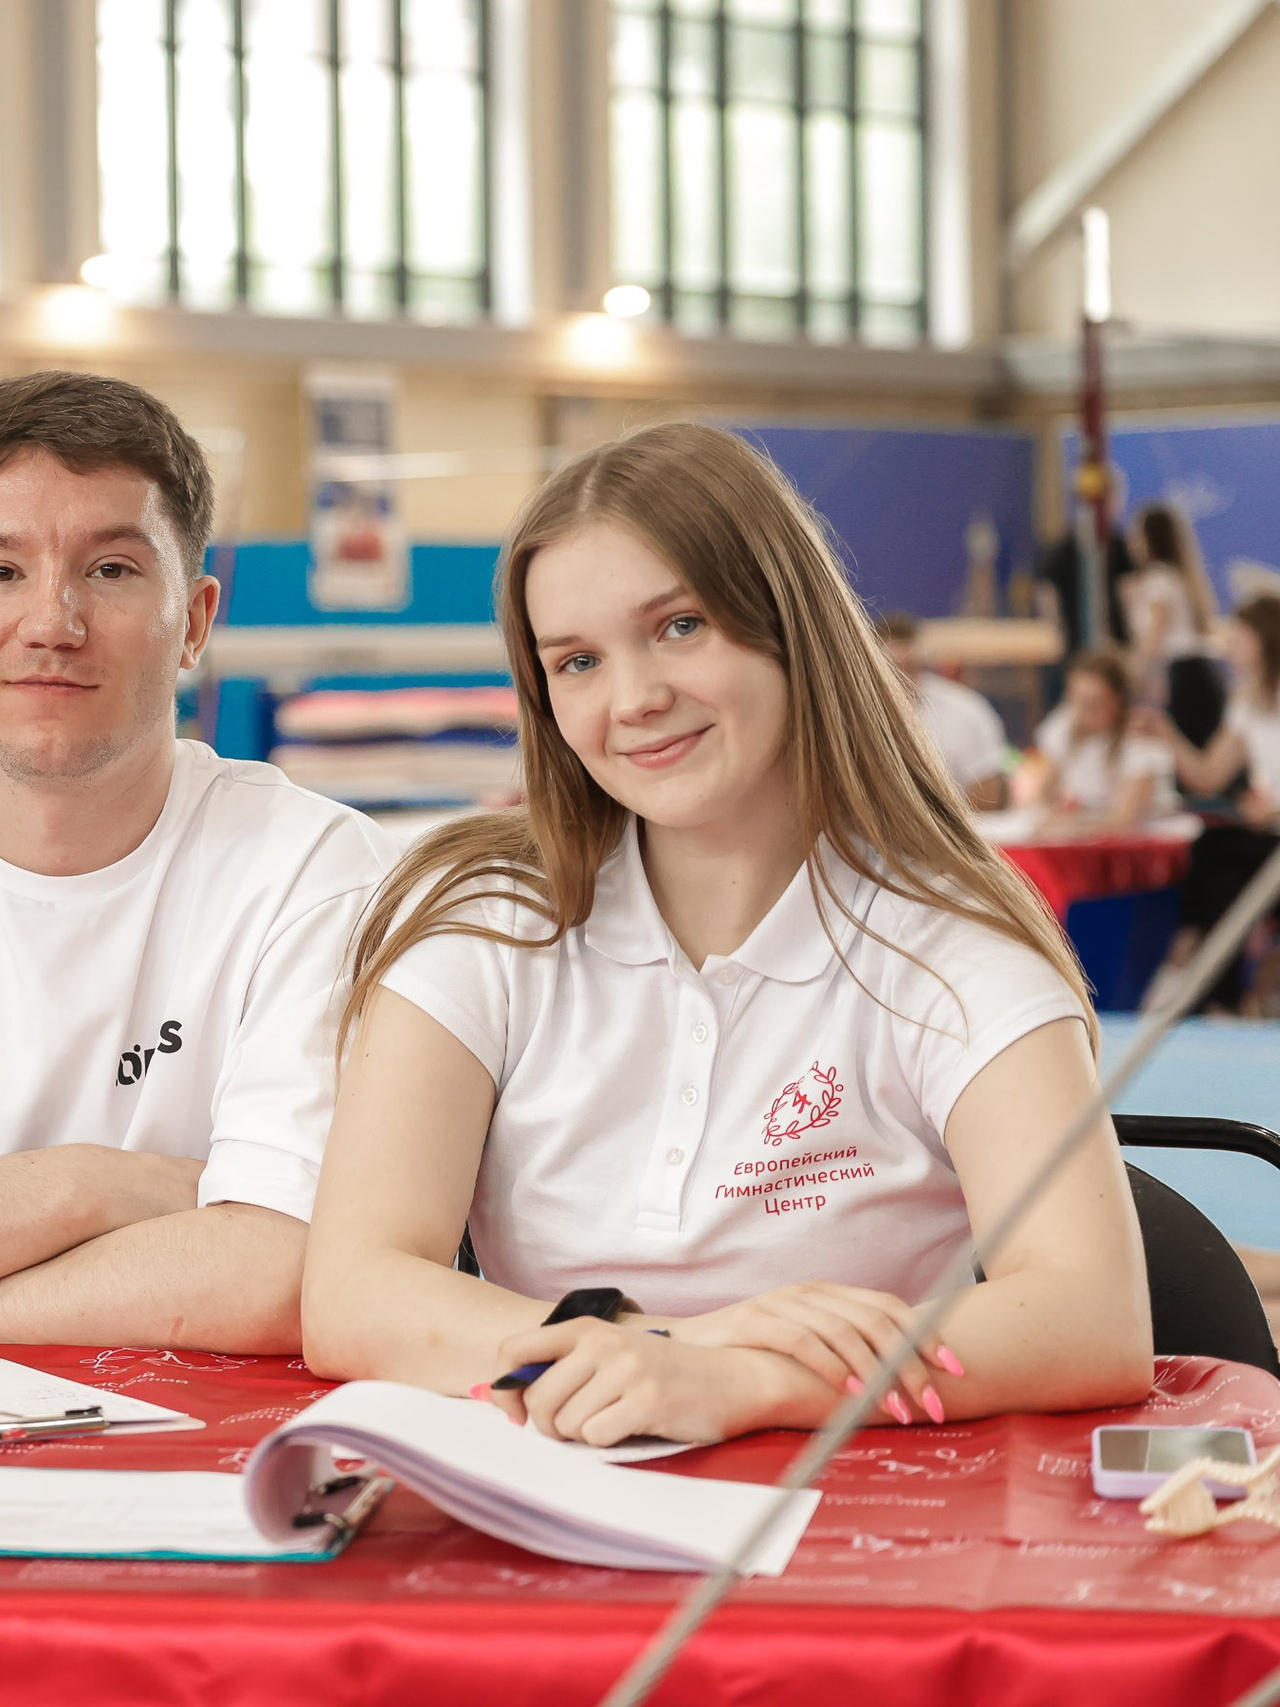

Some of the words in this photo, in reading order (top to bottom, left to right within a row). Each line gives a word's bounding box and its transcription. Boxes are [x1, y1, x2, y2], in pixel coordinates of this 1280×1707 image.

[733, 1146, 858, 1176] Европейский
[715, 1163, 875, 1199] Гимнастический
[764, 1194, 826, 1216] Центр
